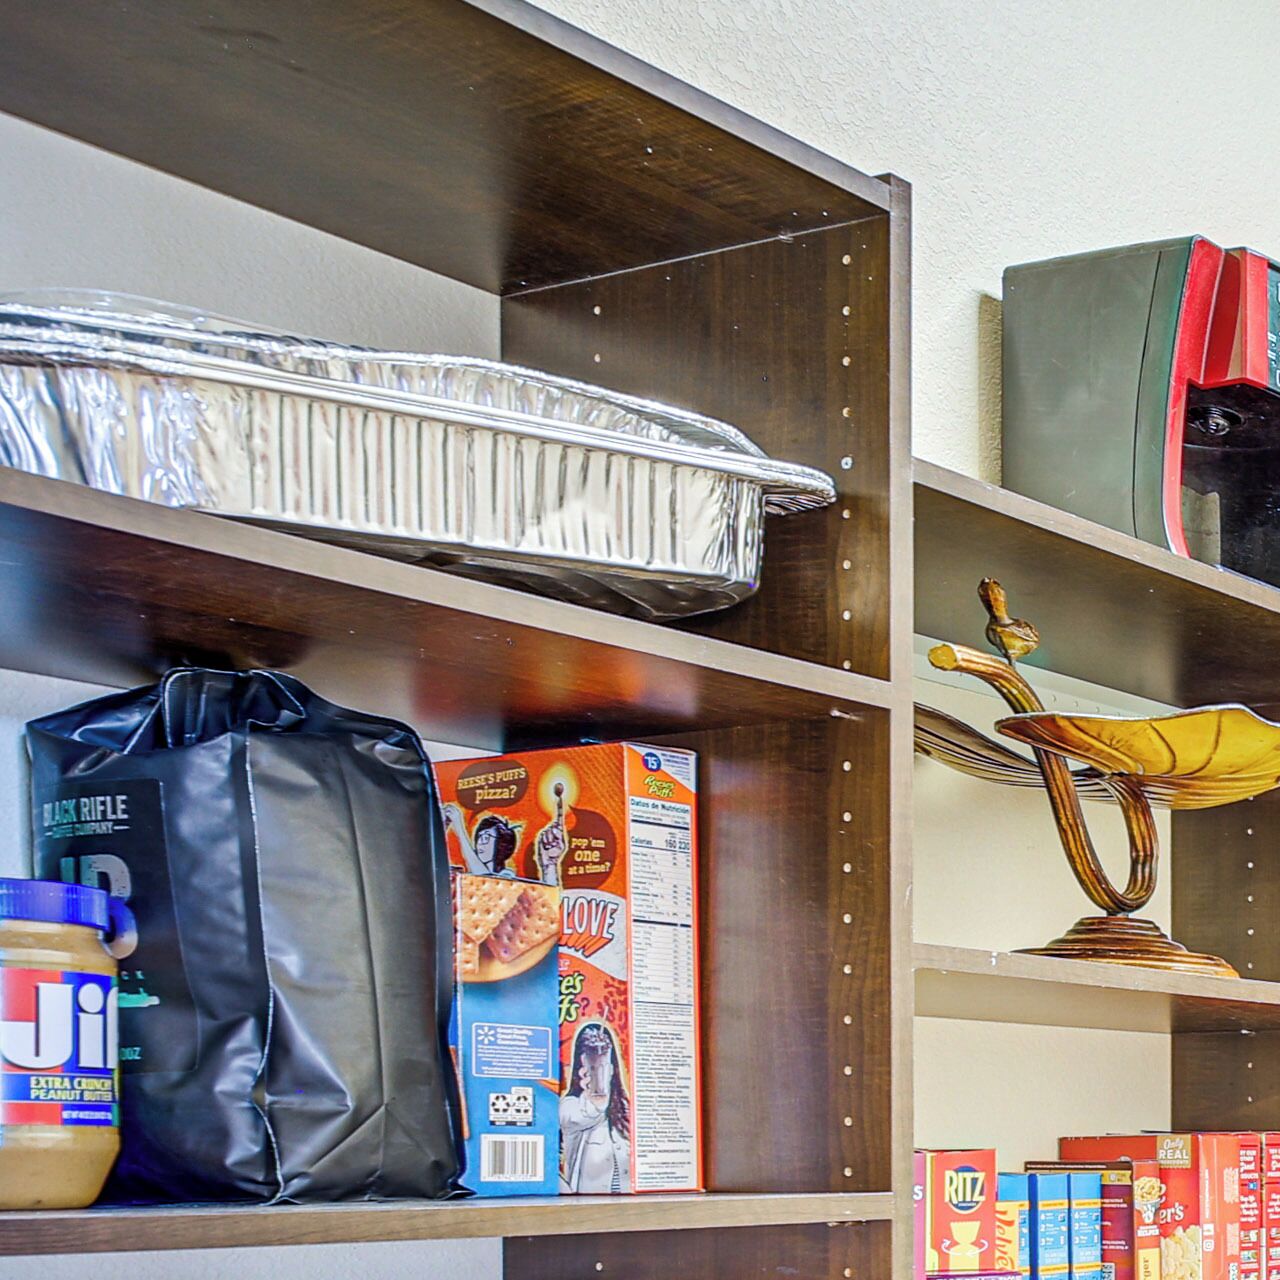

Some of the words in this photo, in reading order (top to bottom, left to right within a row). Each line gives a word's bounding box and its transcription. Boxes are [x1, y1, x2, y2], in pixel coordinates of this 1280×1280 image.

[458, 771, 494, 789] REESE'S
[495, 768, 527, 783] PUFFS
[475, 785, 517, 804] pizza?
[43, 799, 76, 827] BLACK
[80, 795, 129, 821] RIFLE
[571, 838, 588, 849] pop
[574, 850, 600, 862] one
[585, 862, 611, 874] time?
[562, 896, 619, 938] LOVE
[30, 1076, 70, 1089] EXTRA
[30, 1089, 82, 1100] PEANUT
[1158, 1150, 1190, 1160] REAL
[944, 1170, 986, 1204] RITZ
